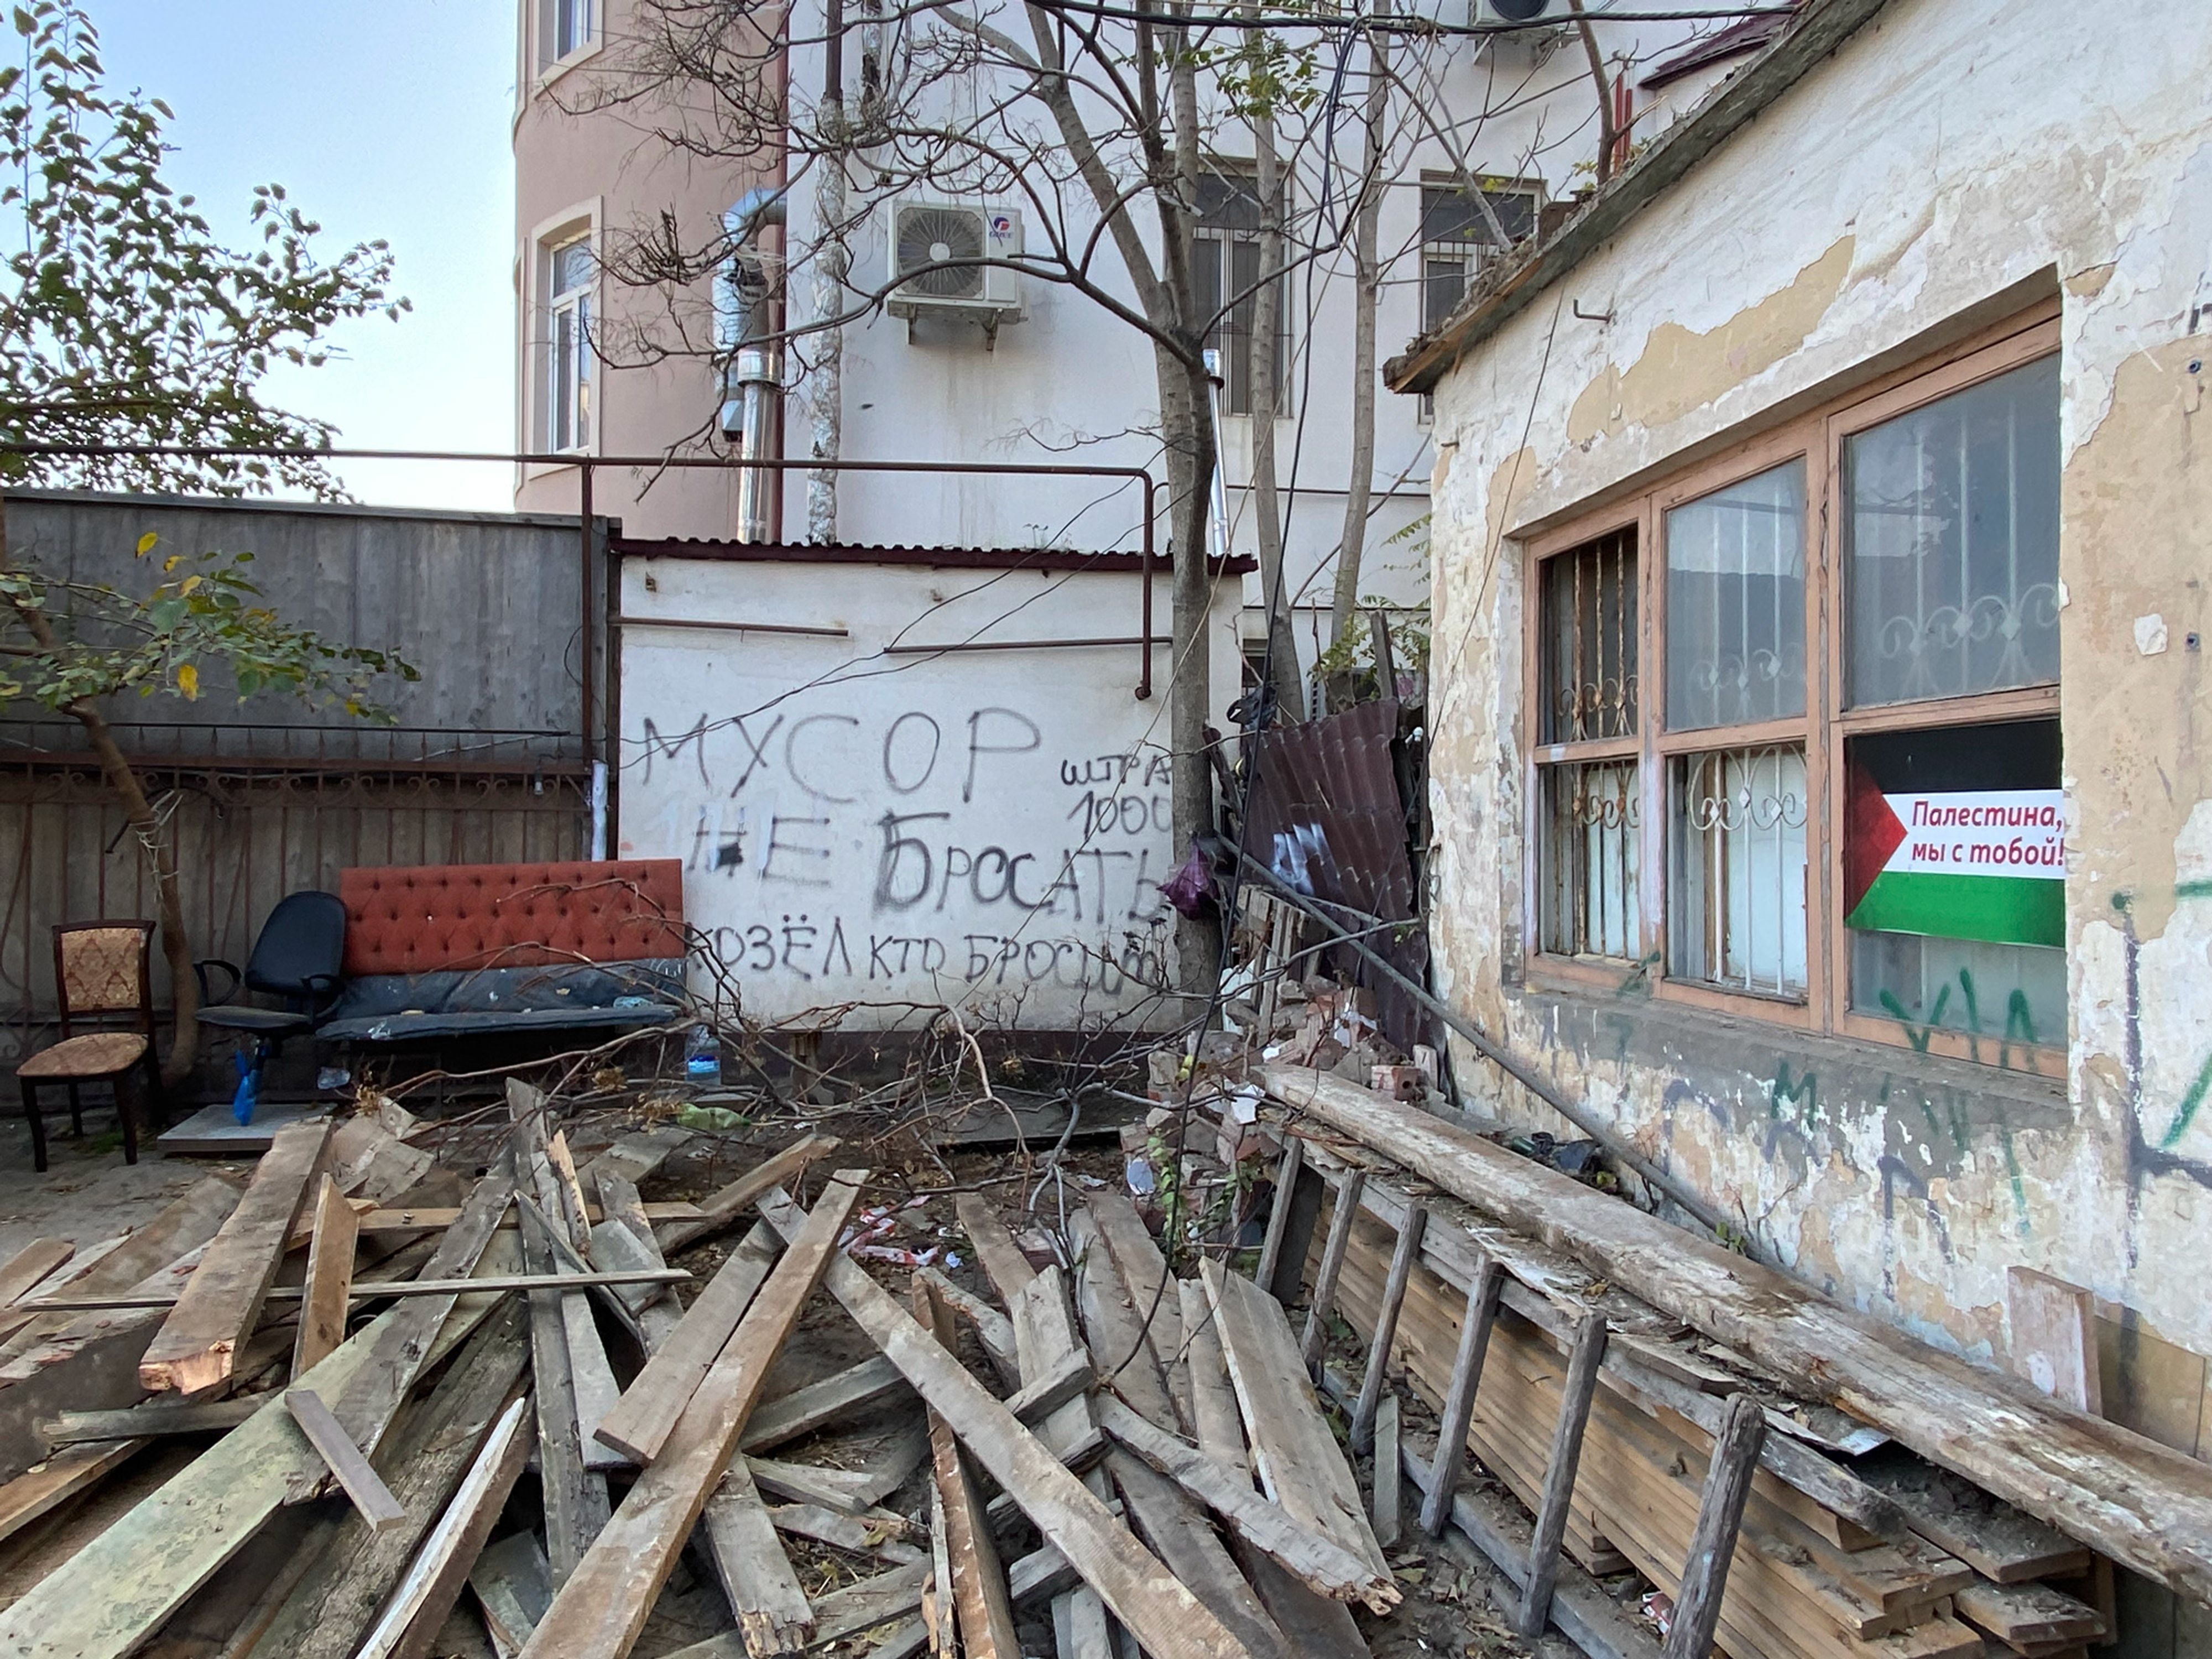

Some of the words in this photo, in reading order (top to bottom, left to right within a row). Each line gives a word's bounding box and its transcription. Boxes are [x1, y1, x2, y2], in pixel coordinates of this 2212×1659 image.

[1060, 753, 1172, 786] ШТРА
[1912, 801, 2063, 832] Палестина,
[688, 805, 831, 886] НЕ
[1912, 843, 1946, 862] мы
[1952, 843, 1963, 862] с
[1969, 836, 2064, 866] тобой!
[869, 935, 946, 980] КТО
